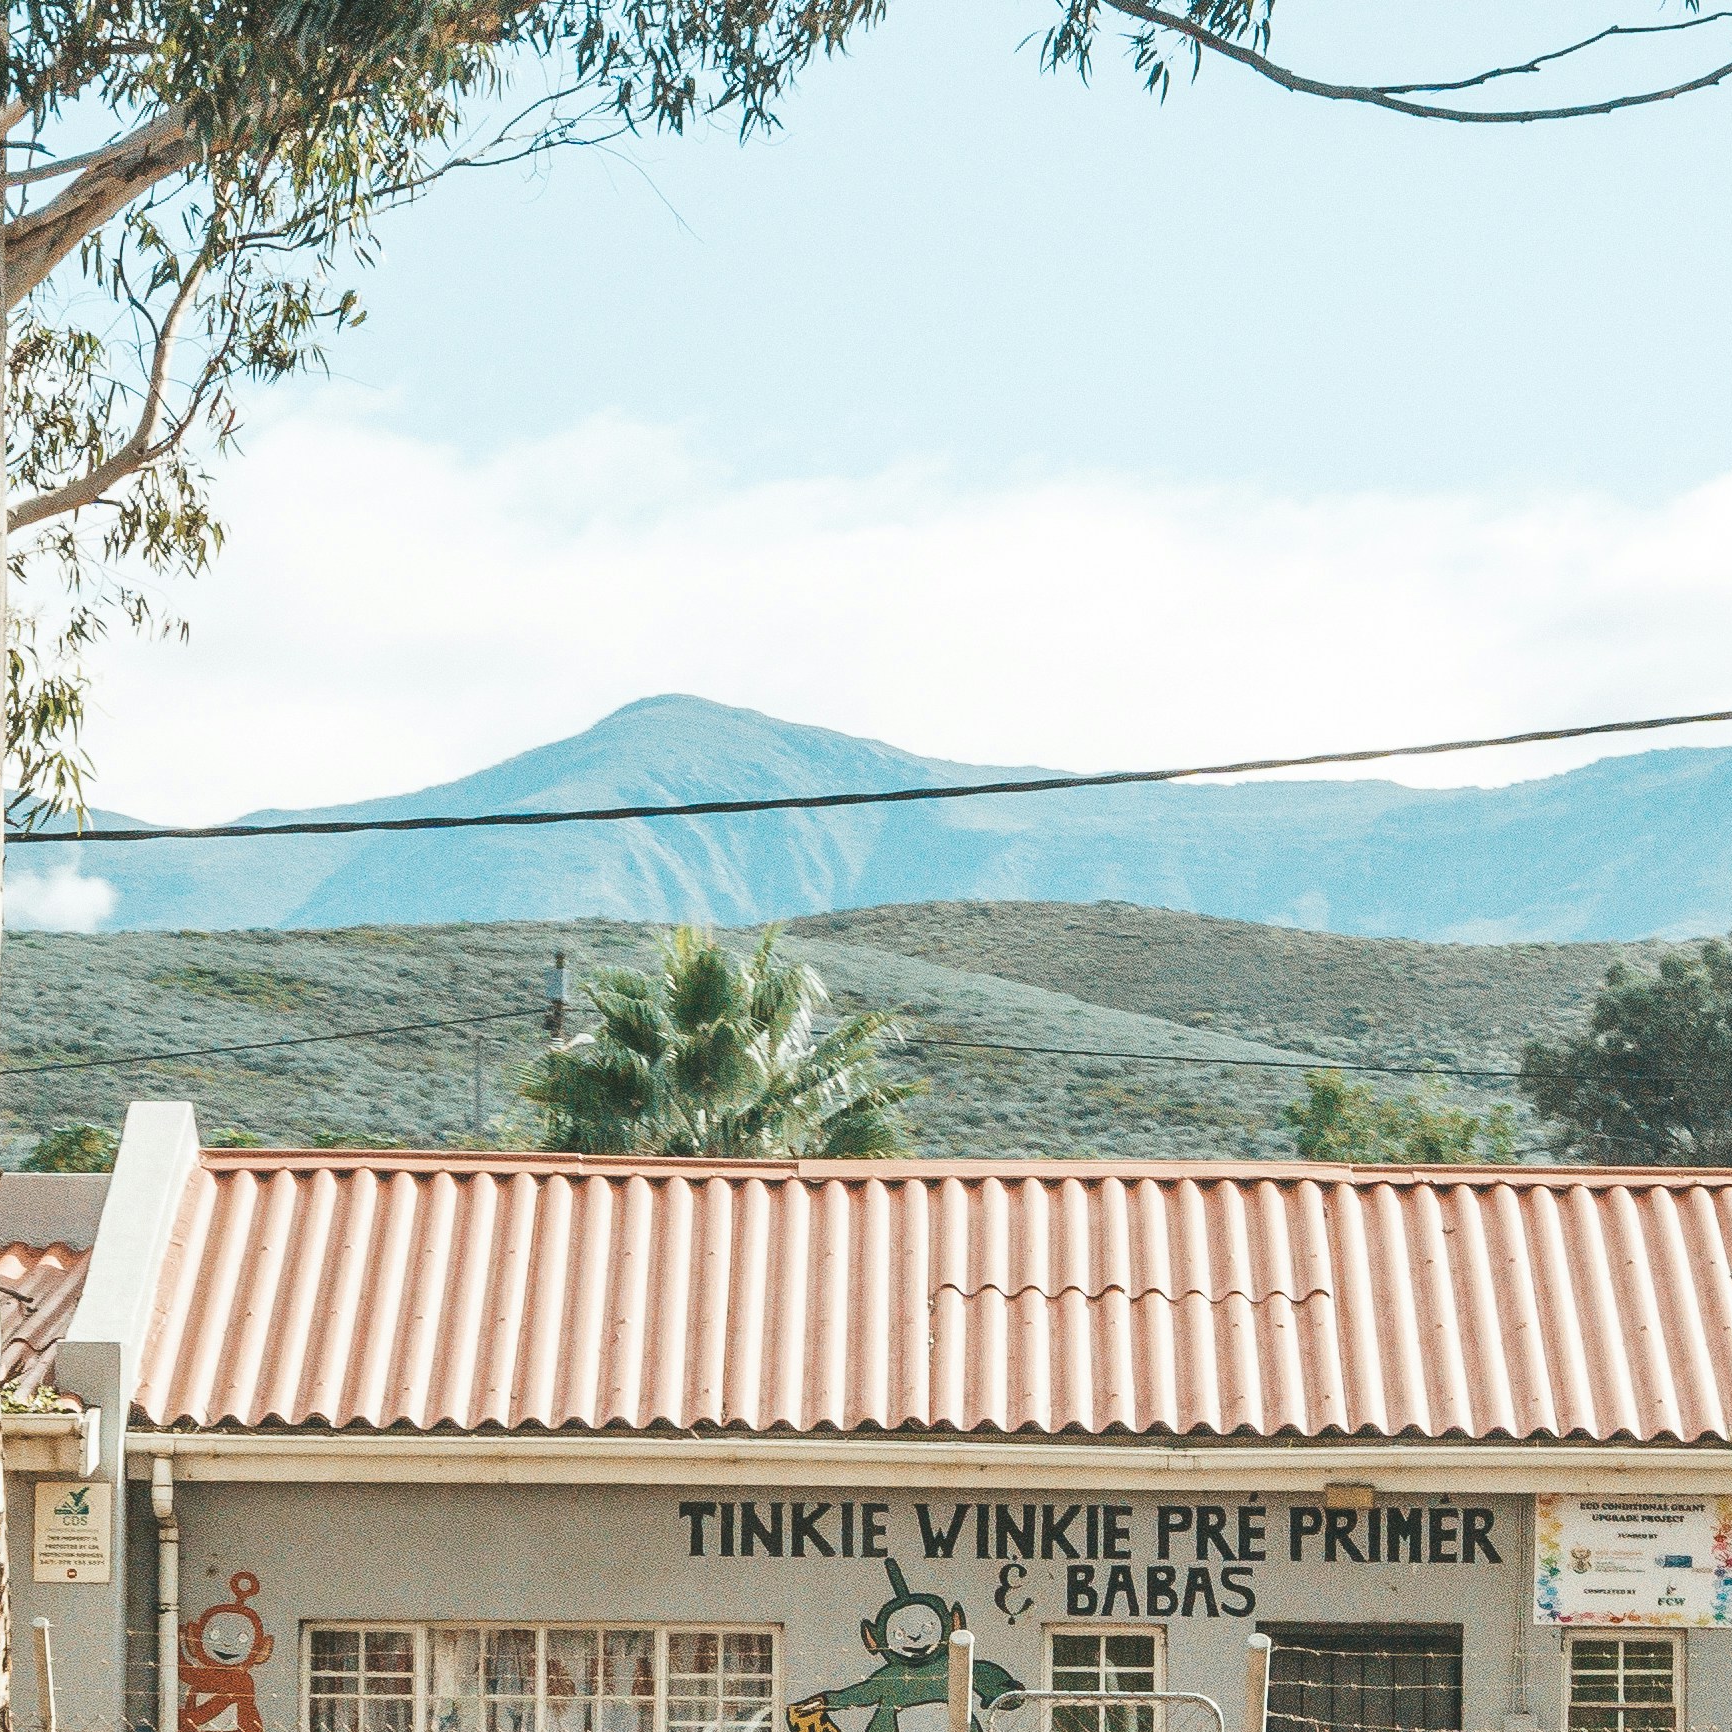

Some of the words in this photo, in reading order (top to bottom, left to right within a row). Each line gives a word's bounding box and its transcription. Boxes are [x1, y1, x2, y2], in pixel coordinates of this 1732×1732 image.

[1592, 1514, 1639, 1522] UPGRADE
[1641, 1514, 1685, 1523] PROJECT
[1601, 1502, 1669, 1511] CONDITIONAL
[1671, 1503, 1706, 1512] GRANT
[679, 1501, 890, 1558] TINKIE
[914, 1502, 1133, 1560] WINKIE
[1156, 1493, 1267, 1562] PRÉ
[994, 1555, 1034, 1626] &
[1066, 1564, 1257, 1618] BABAS
